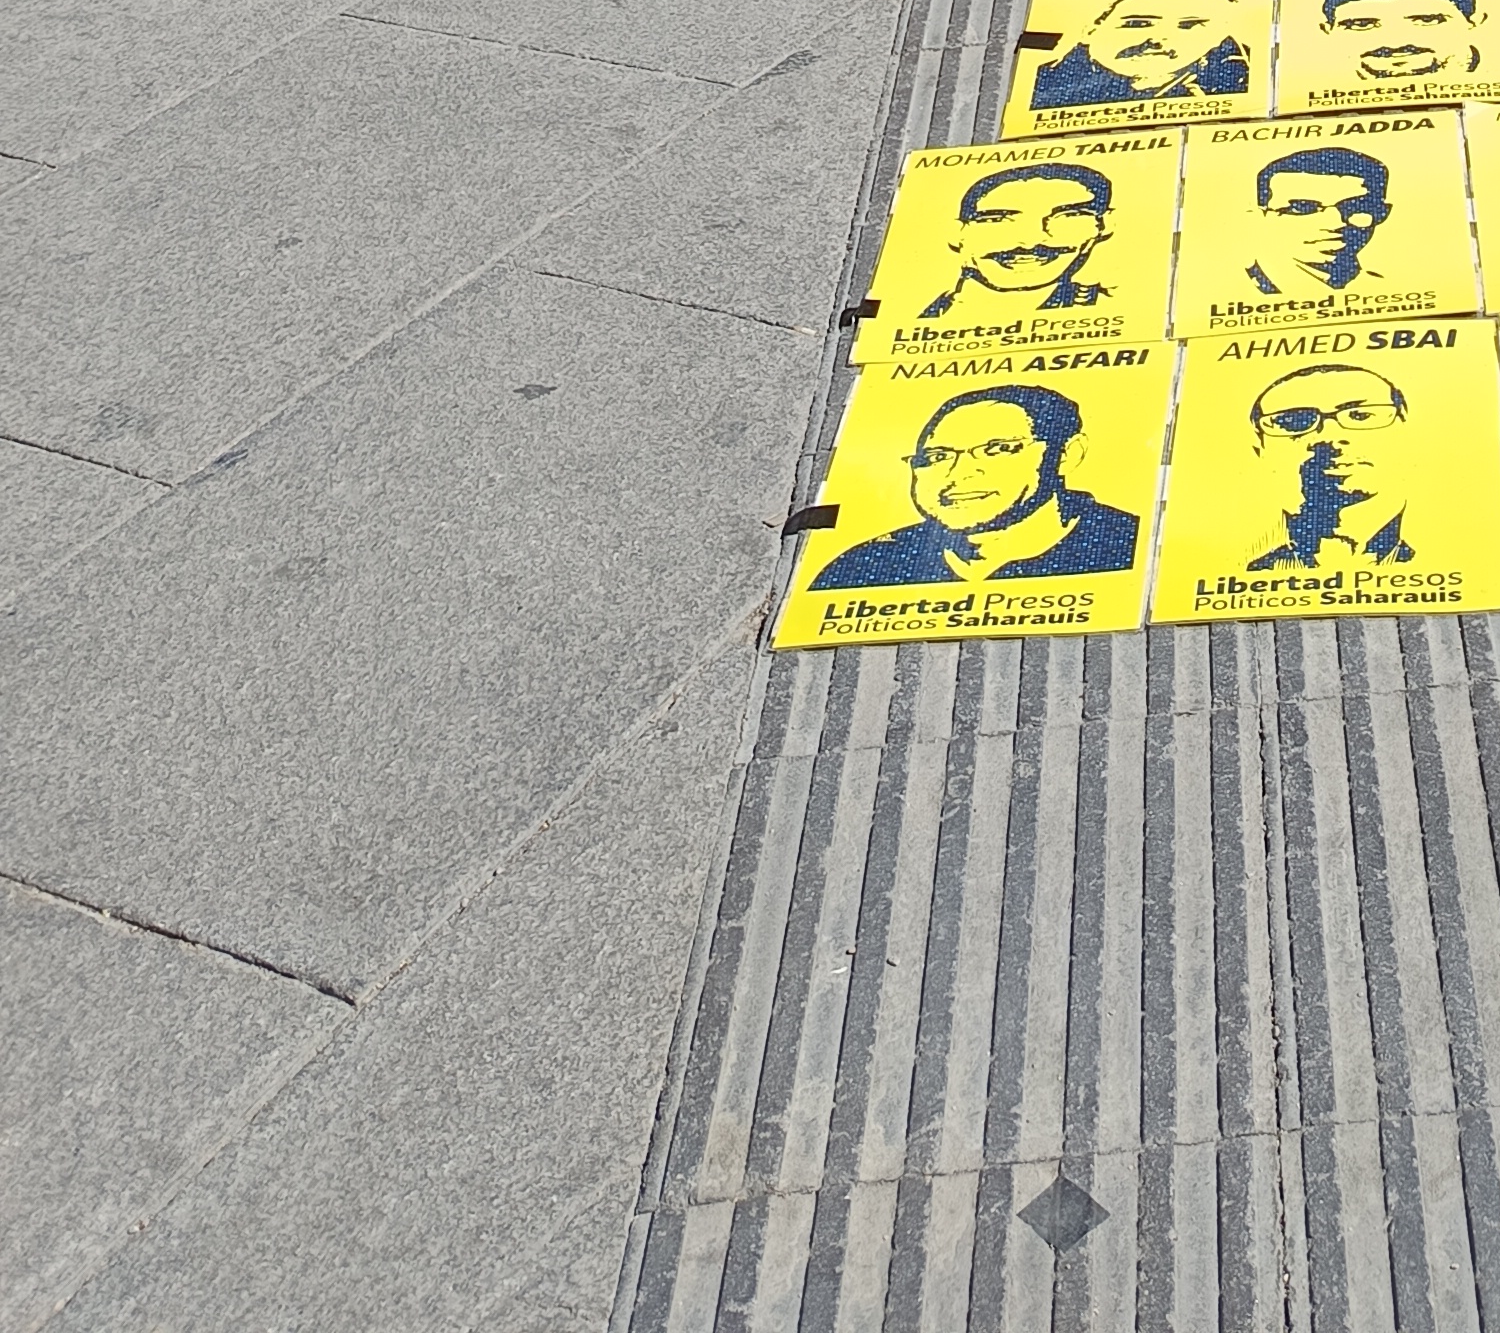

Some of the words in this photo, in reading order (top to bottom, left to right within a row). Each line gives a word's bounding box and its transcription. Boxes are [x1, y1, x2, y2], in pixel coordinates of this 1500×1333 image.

[1211, 126, 1323, 144] BACHIR
[1330, 116, 1436, 137] JADDA
[915, 145, 1066, 169] MOHAMED
[1075, 136, 1173, 156] TAHLIL
[1218, 333, 1357, 362] AHMED
[1365, 329, 1457, 353] SBAI
[891, 356, 1015, 380] NAAMA
[1022, 349, 1149, 374] ASFARI
